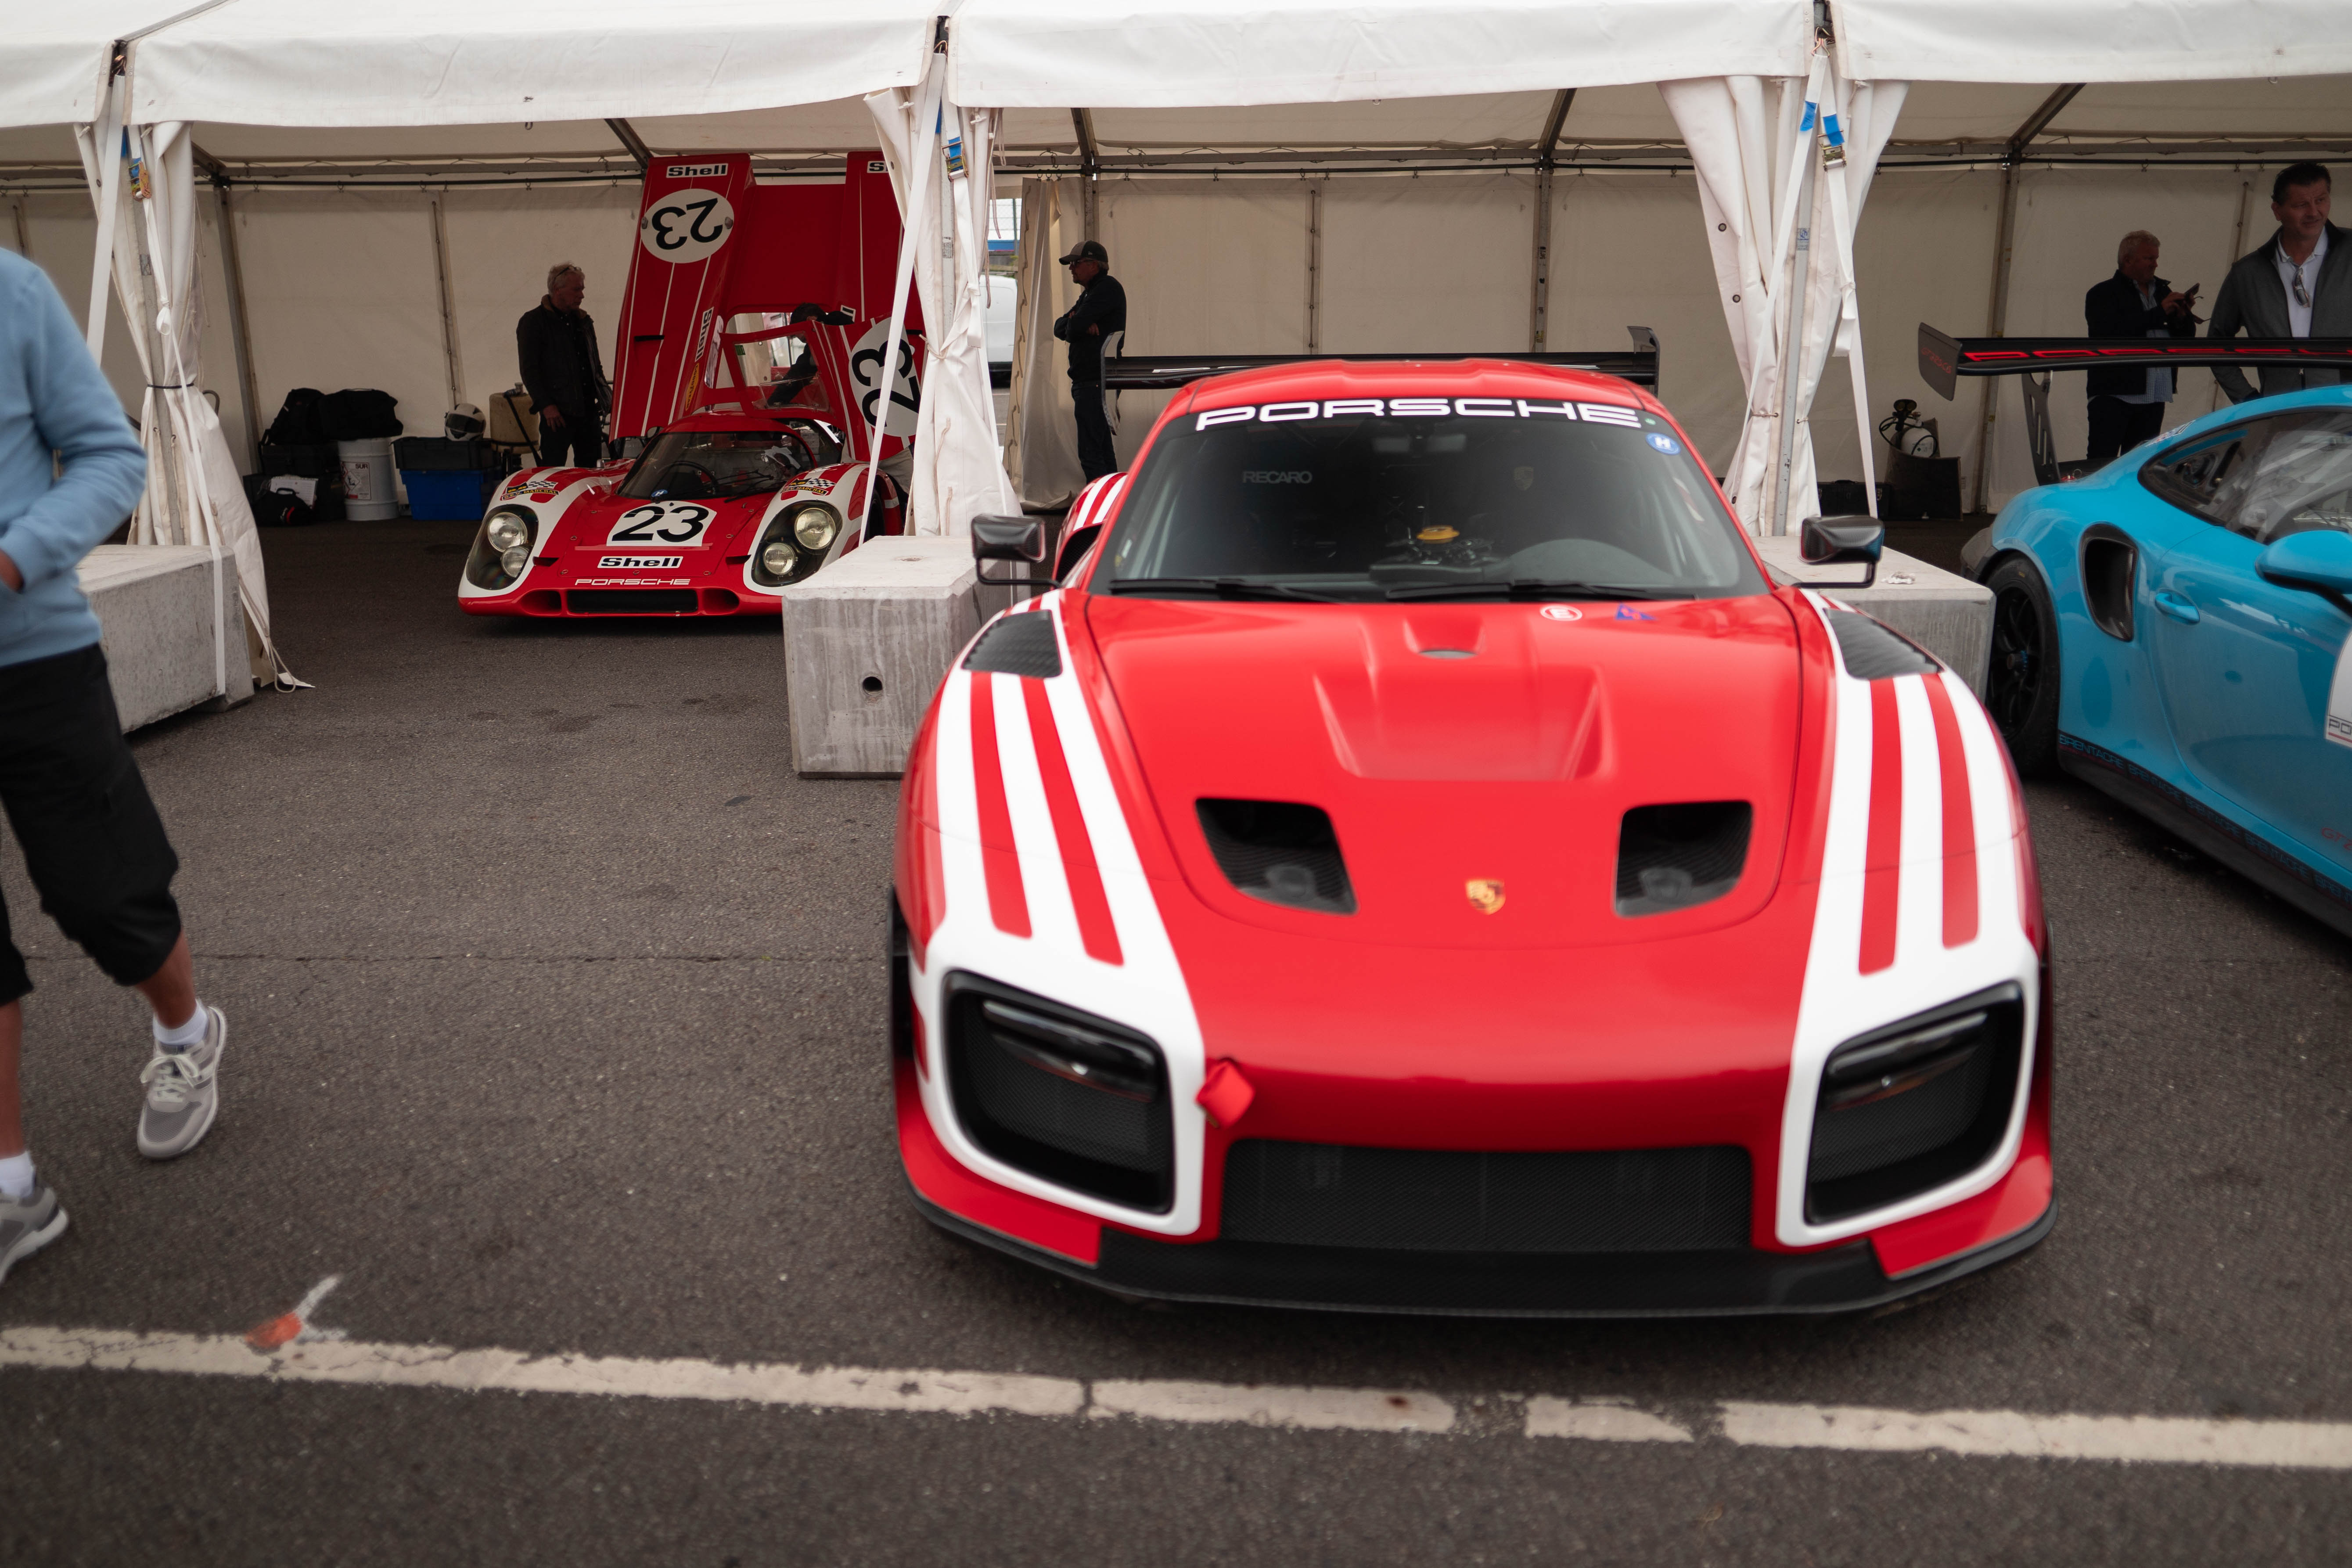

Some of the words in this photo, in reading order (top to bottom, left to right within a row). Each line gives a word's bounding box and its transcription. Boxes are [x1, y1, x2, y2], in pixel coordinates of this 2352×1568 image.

[668, 165, 726, 176] Shell
[651, 198, 723, 250] 23
[696, 309, 713, 360] Shell
[851, 338, 921, 427] 23
[1196, 398, 1642, 432] PORSCHE
[1243, 471, 1313, 484] RECARO
[611, 506, 709, 543] 23
[601, 557, 681, 567] Shell
